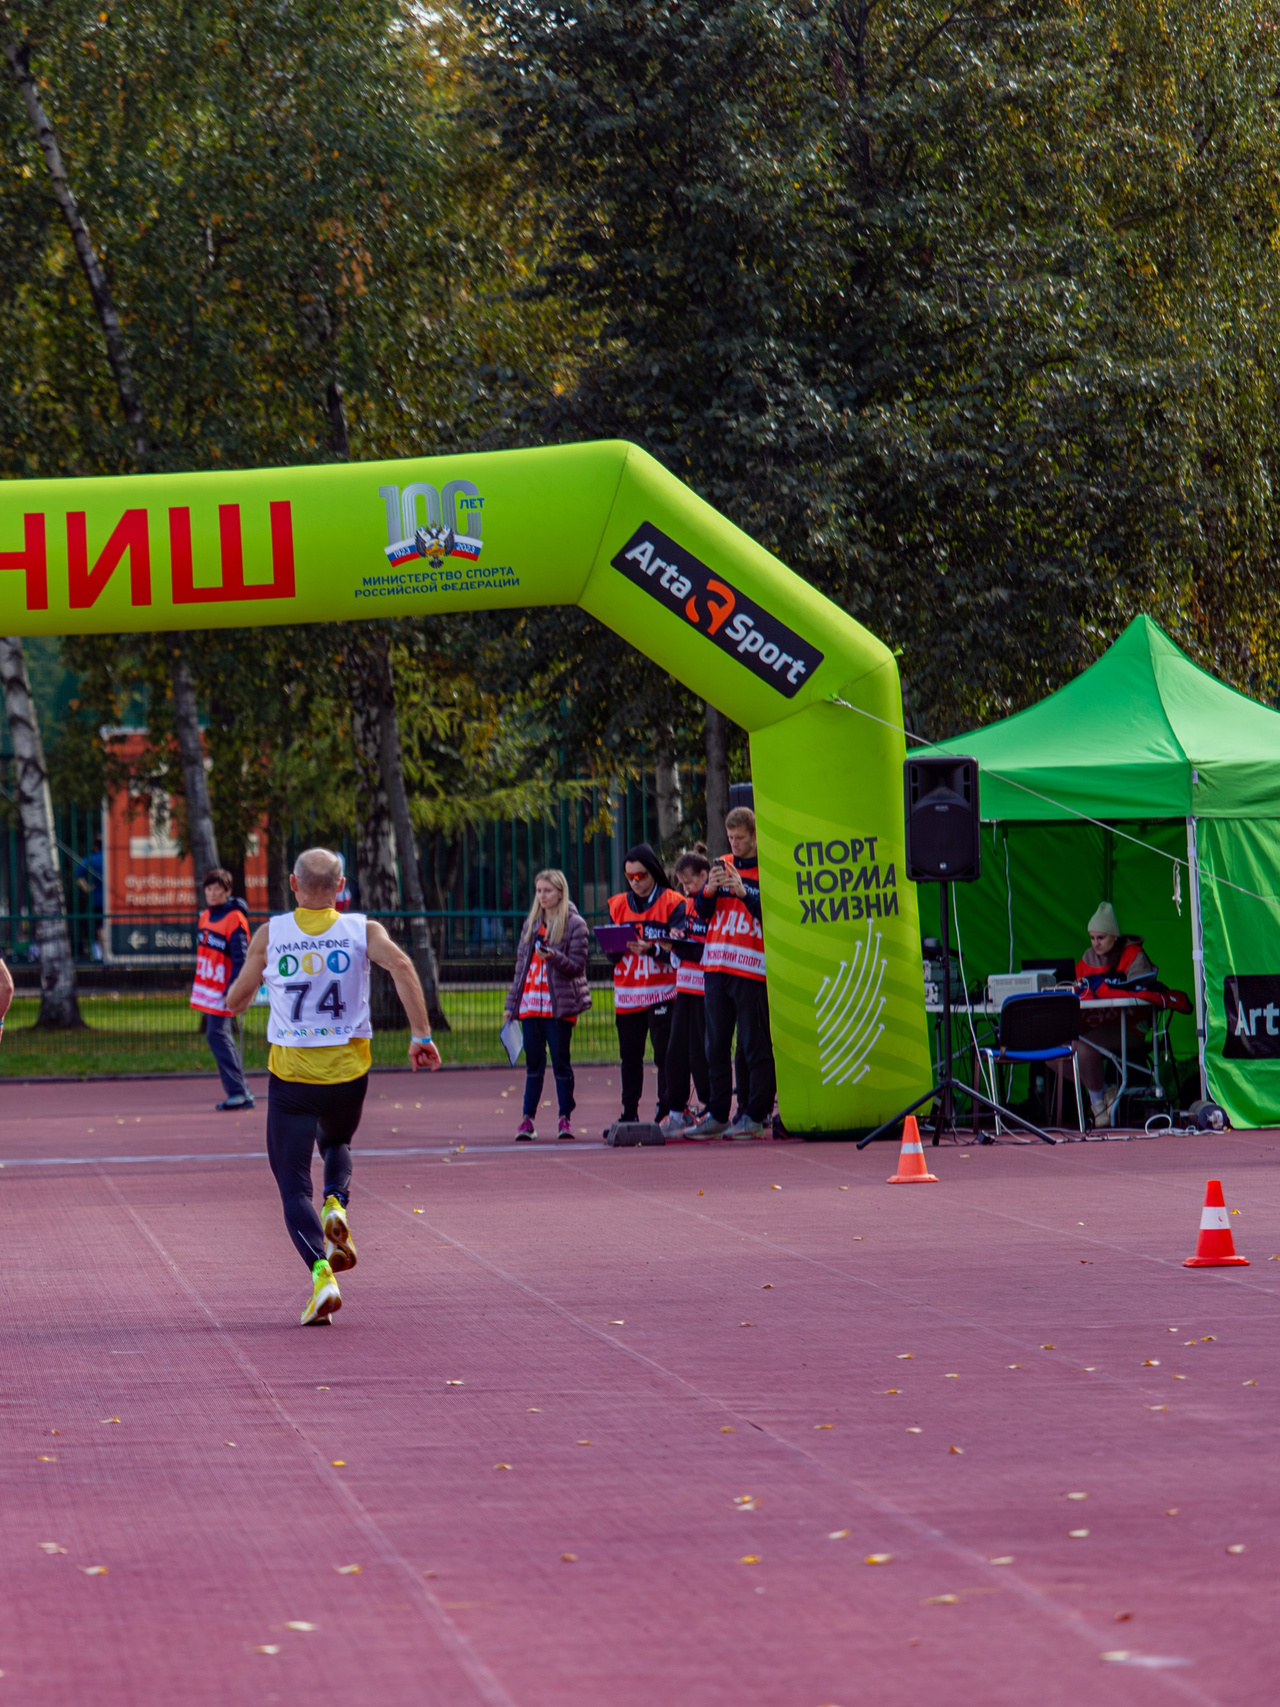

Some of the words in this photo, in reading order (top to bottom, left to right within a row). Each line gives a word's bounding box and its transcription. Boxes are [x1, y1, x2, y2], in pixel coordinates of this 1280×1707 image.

[460, 497, 485, 510] ЛЕТ
[393, 547, 412, 559] 1923
[455, 542, 476, 554] 2023
[354, 581, 438, 598] РОССИЙСКОЙ
[441, 577, 520, 592] ФЕДЕРАЦИИ
[362, 570, 462, 587] МИНИСТЕРСТВО
[466, 566, 515, 579] СПОРТА
[624, 540, 692, 600] Arta
[724, 612, 807, 685] Sport
[793, 836, 878, 867] СПОРТ
[795, 862, 897, 896] НОРМА
[798, 891, 899, 925] ЖИЗНИ
[709, 909, 763, 940] УДЬЯ
[275, 938, 350, 954] VMARAFONE
[196, 956, 226, 985] ДЬЯ
[738, 953, 762, 969] СПОРТ
[284, 980, 347, 1023] 74
